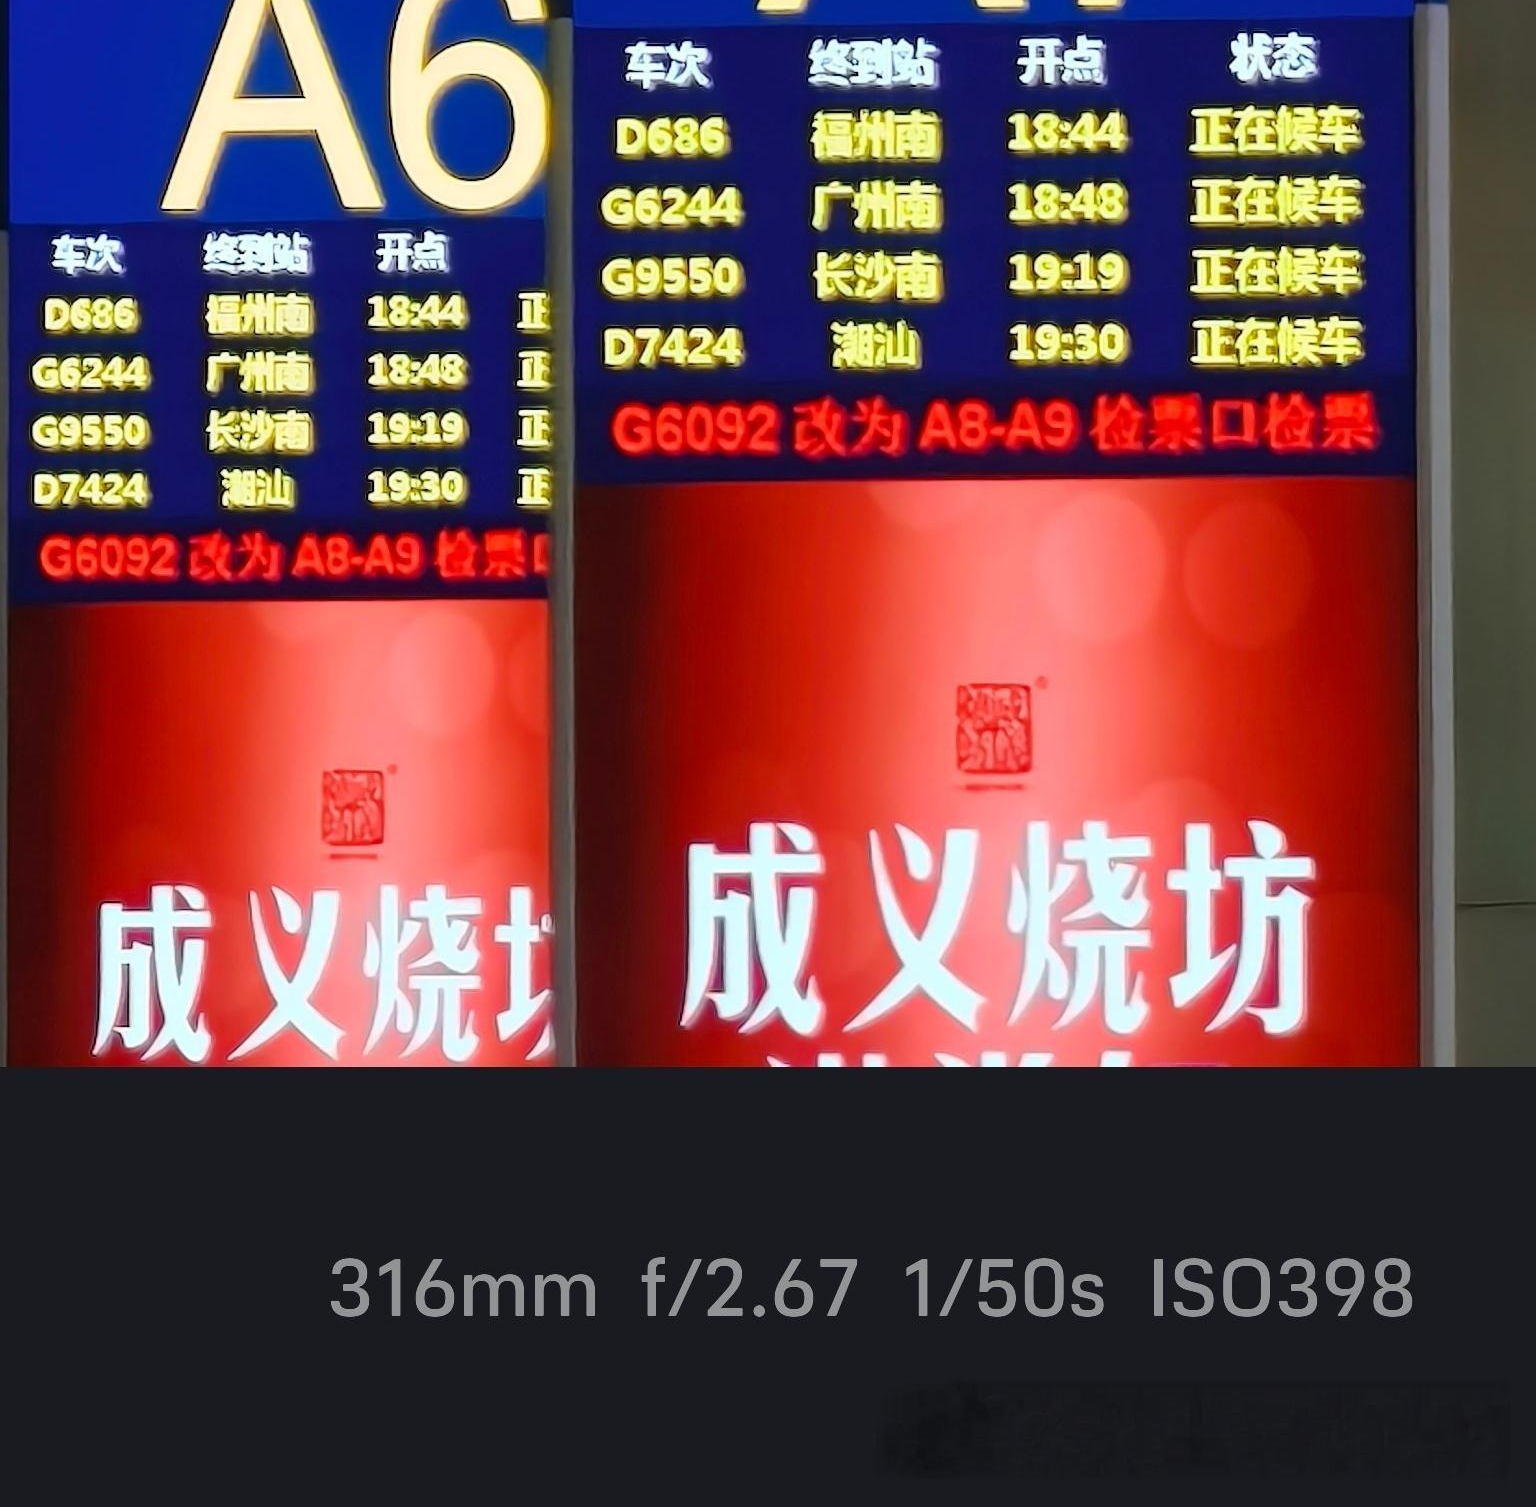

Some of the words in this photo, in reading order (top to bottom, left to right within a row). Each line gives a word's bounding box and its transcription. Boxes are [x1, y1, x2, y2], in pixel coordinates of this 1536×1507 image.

[625, 41, 710, 90] 车次
[808, 38, 939, 88] 终到站
[1017, 35, 1106, 86] 开点
[1229, 32, 1318, 82] 状态
[617, 117, 729, 158] D686
[810, 109, 941, 161] 福州南
[1008, 111, 1128, 153] 18:44
[1189, 105, 1362, 155] 正在候车
[601, 186, 744, 228] G6244
[812, 180, 942, 231] 广州南
[1009, 183, 1128, 224] 18:48
[1190, 175, 1363, 226] 正在候车
[52, 234, 124, 276] 车次
[203, 232, 311, 275] 终到站
[376, 231, 449, 272] 开点
[602, 257, 743, 298] G9550
[813, 250, 942, 302] 长沙南
[1010, 251, 1128, 294] 19:19
[1190, 246, 1362, 297] 正在候车
[45, 297, 138, 333] D686
[205, 293, 314, 337] 福州南
[368, 295, 468, 330] 18:44
[605, 328, 744, 368] D7424
[1010, 323, 1128, 364] 19:30
[1190, 316, 1364, 367] 正在候车
[32, 355, 151, 392] G6244
[206, 351, 314, 395] 广州南
[368, 353, 467, 389] 18:48
[33, 415, 150, 450] G9550
[206, 410, 313, 454] 长沙南
[368, 412, 468, 447] 19:19
[612, 402, 780, 455] G6092
[794, 397, 907, 458] 改为
[918, 400, 1079, 452] A8-A9
[1089, 393, 1378, 454] 检票口检票
[34, 473, 149, 508] D7424
[368, 471, 467, 506] 19:30
[40, 535, 179, 580] G6092
[189, 532, 283, 582] 改为
[291, 534, 425, 579] A8-A9
[681, 812, 1314, 1035] 成义烧坊
